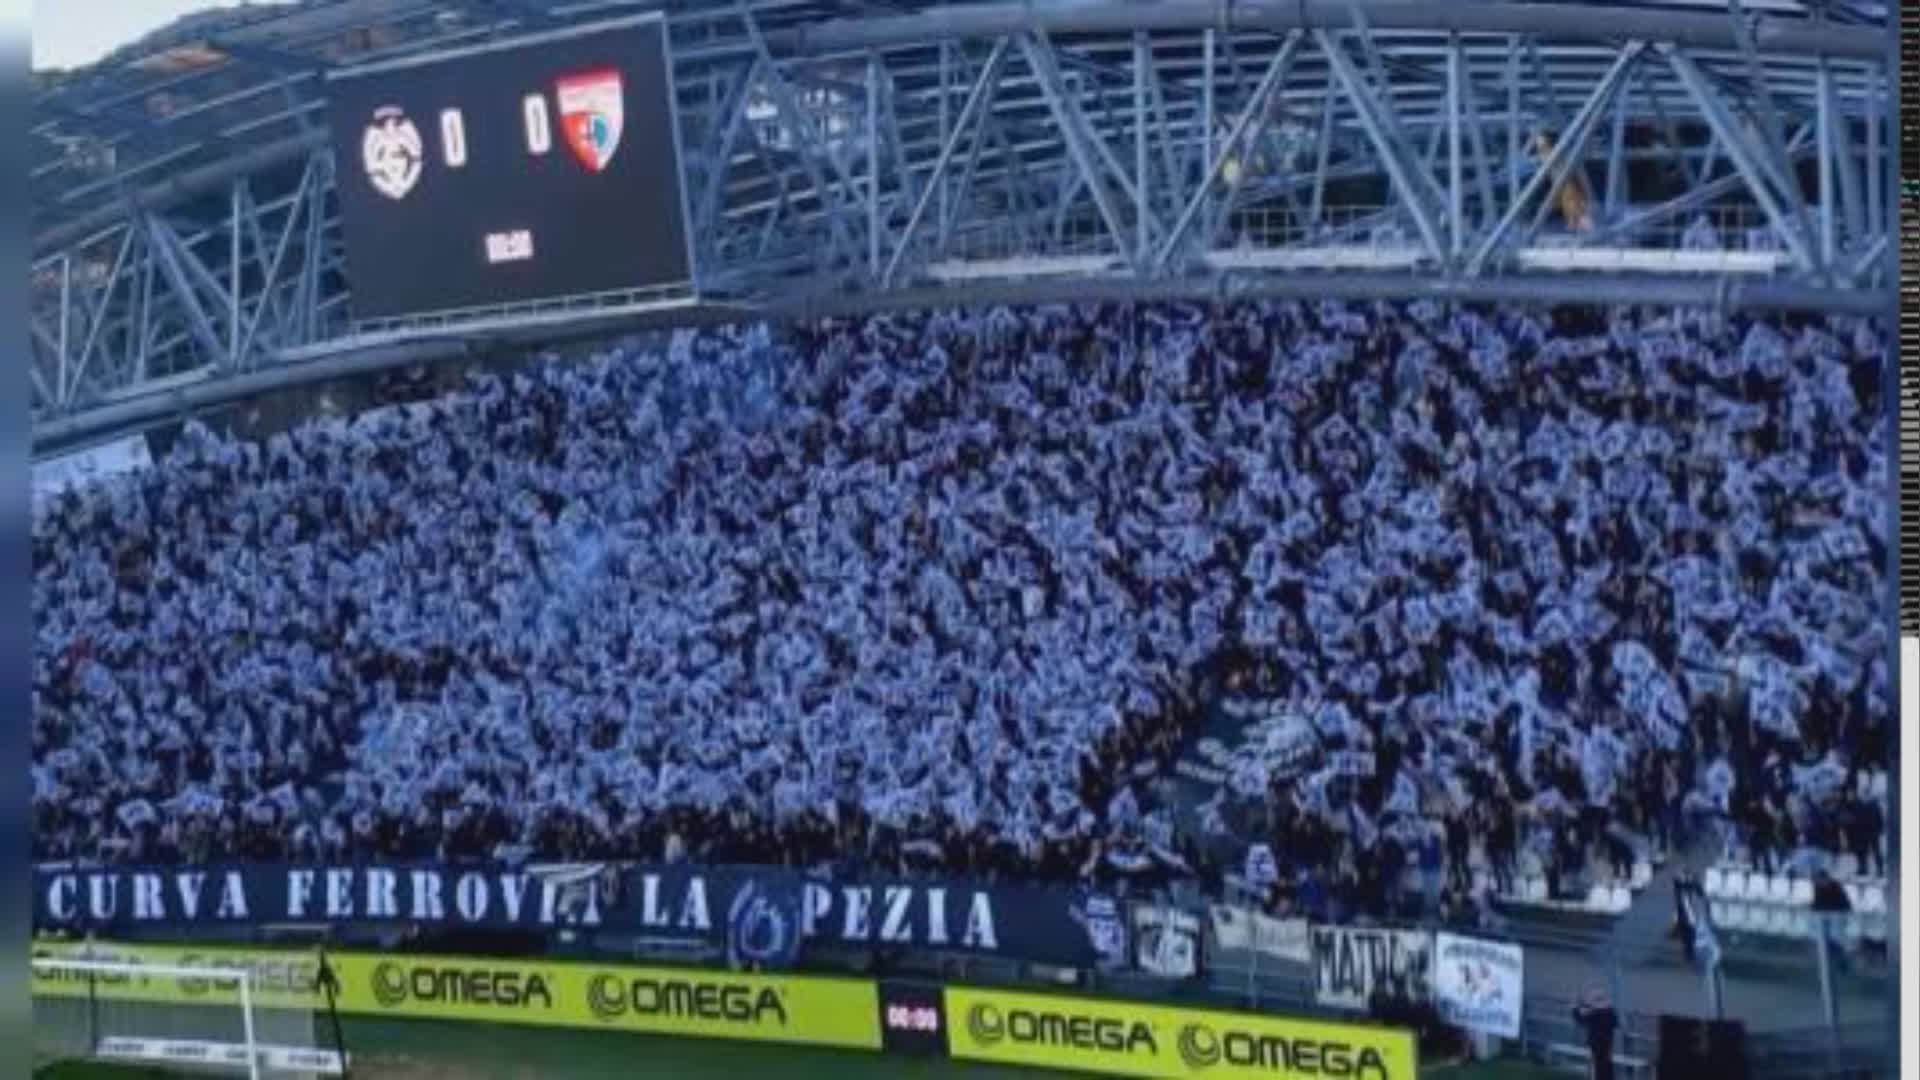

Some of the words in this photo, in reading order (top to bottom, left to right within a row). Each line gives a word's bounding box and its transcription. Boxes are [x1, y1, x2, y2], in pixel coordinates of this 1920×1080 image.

[440, 107, 467, 166] 0
[524, 93, 551, 155] 0
[48, 871, 249, 919] CURVA
[643, 874, 712, 929] LA
[801, 882, 998, 948] PEZIA
[409, 966, 552, 1008] OMEGA
[630, 979, 788, 1024] OMEGA
[1008, 1010, 1158, 1055] OMEGA
[1223, 1031, 1388, 1080] OMEGA
